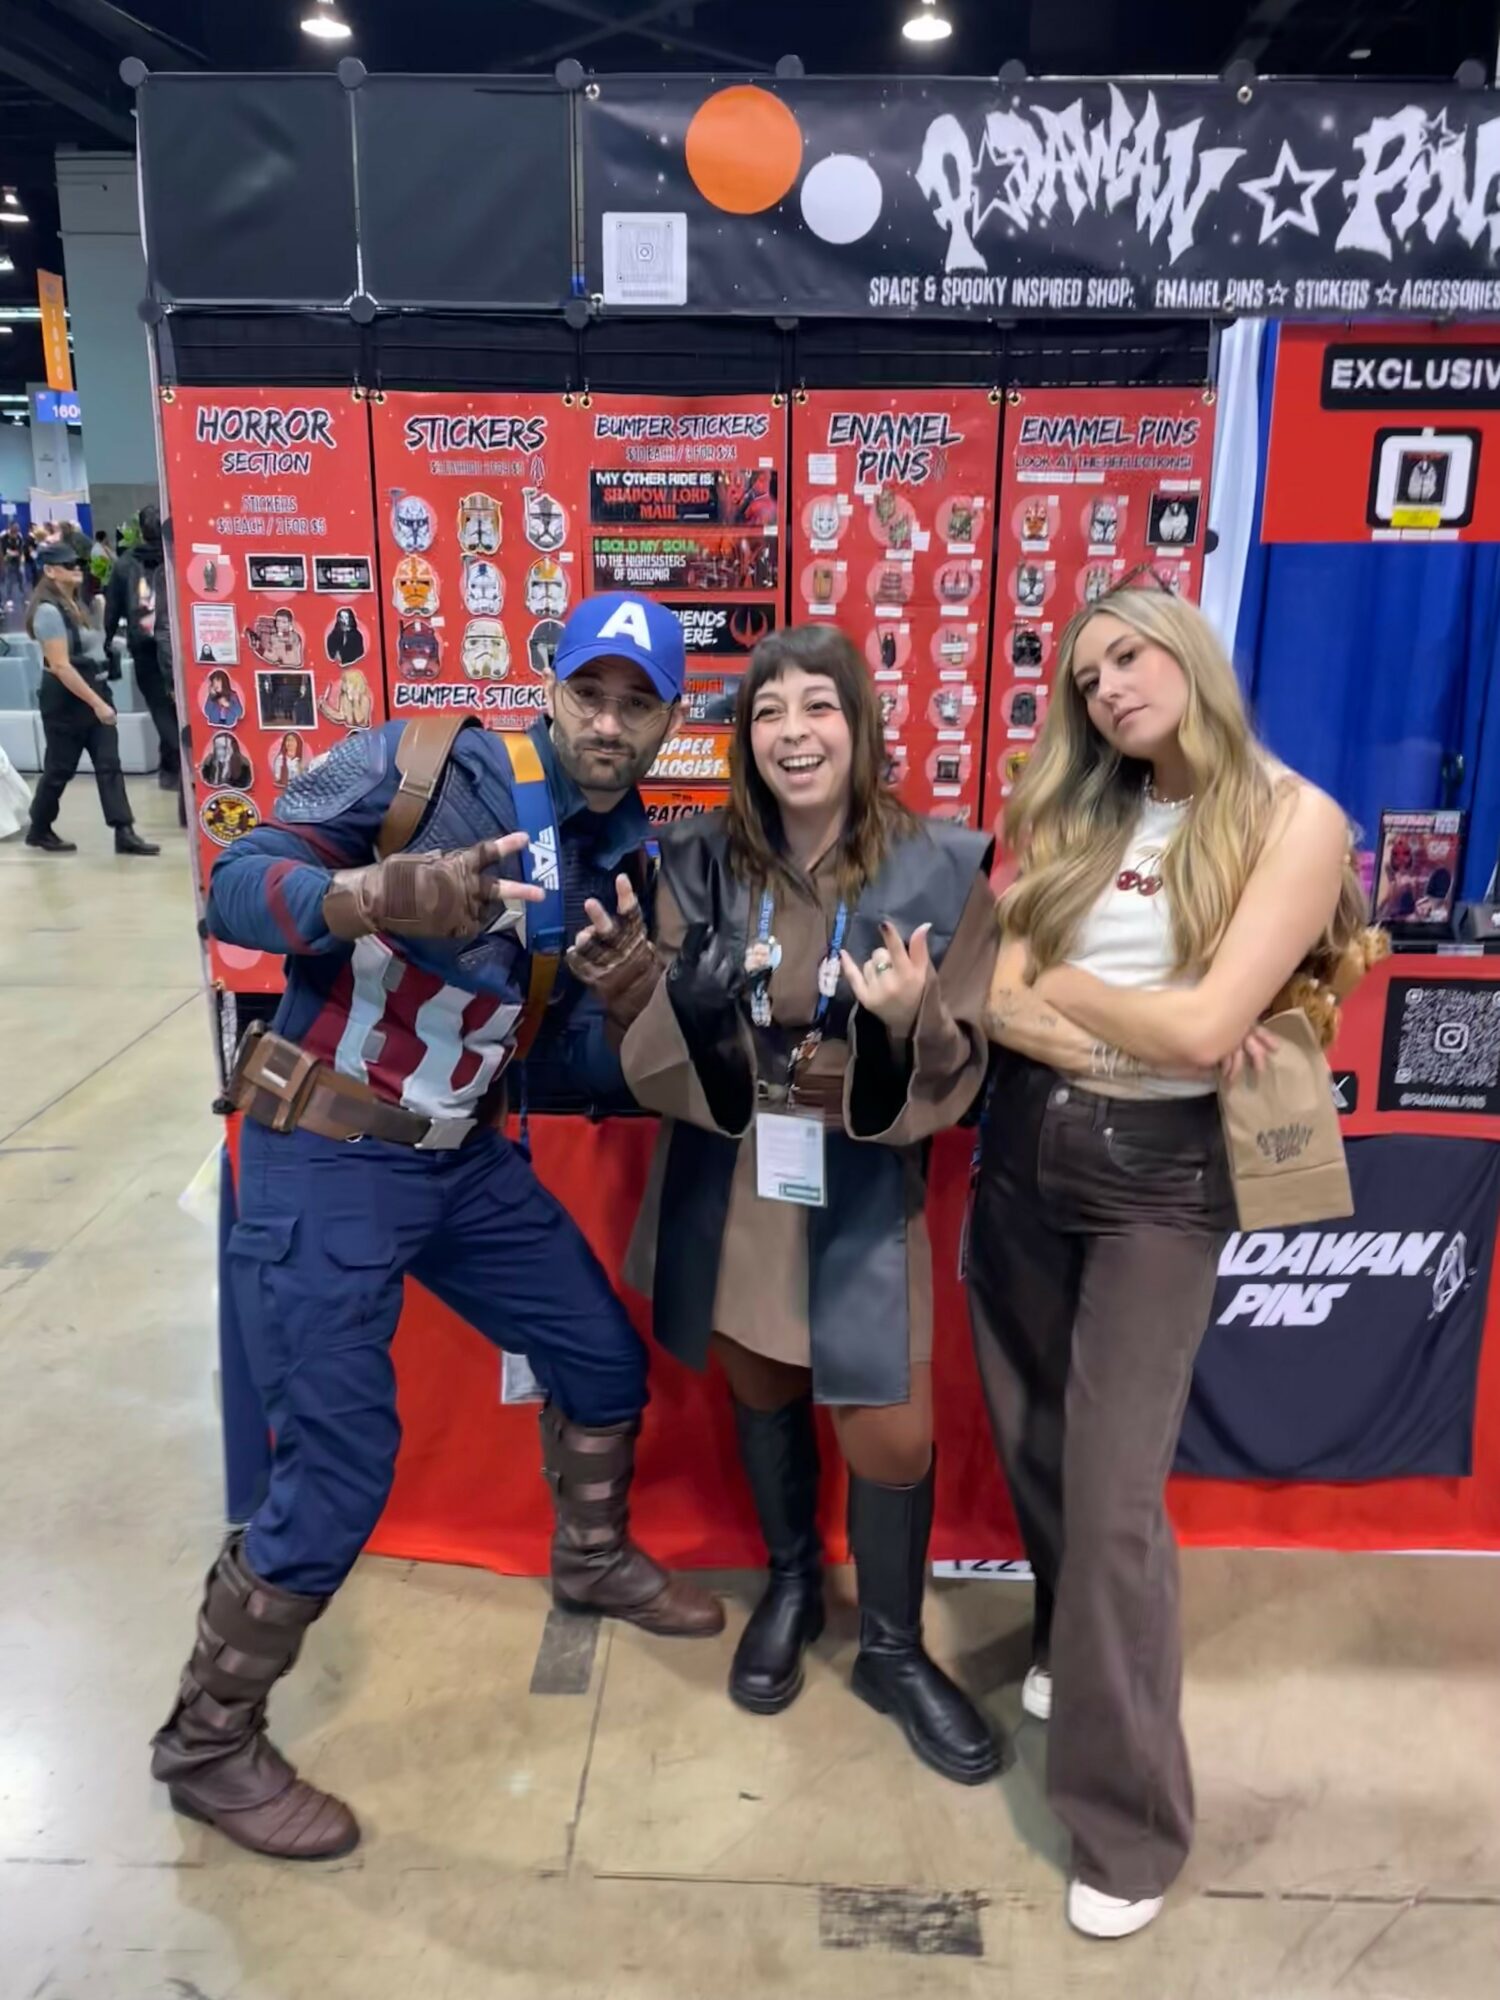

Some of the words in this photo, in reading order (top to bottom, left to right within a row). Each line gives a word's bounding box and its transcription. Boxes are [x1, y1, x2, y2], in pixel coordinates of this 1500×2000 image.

[869, 276, 919, 306] SPACE
[924, 276, 936, 302] &
[942, 276, 1007, 306] SPOOKY
[1012, 277, 1082, 308] INSPIRED
[1154, 278, 1219, 308] ENAMEL
[1223, 278, 1264, 308] PINS
[1294, 279, 1368, 310] STICKERS
[196, 405, 337, 449] HORROR
[405, 415, 547, 454] STICKERS
[595, 414, 675, 440] BUMPER
[678, 414, 770, 440] STICKERS
[828, 413, 965, 448] ENAMEL
[1020, 416, 1132, 448] ENAMEL
[1138, 417, 1200, 447] PINS
[222, 450, 312, 477] SECTION
[857, 449, 931, 485] PINS
[596, 472, 618, 486] MY
[622, 472, 667, 486] OTHER
[669, 472, 698, 486] RIDE
[241, 494, 298, 514] STICKERS
[604, 487, 668, 503] SHADOW
[673, 487, 710, 502] LORD
[234, 516, 265, 536] EACH
[286, 518, 309, 536] FOR
[602, 539, 639, 553] SOLD
[641, 539, 659, 553] MY
[595, 555, 607, 568] TO
[609, 555, 624, 568] THE
[626, 554, 687, 568] NIGHTSISTERS
[614, 568, 626, 581] OF
[596, 600, 652, 652] A
[395, 684, 482, 710] BUMPER
[1215, 1282, 1351, 1328] PINS
